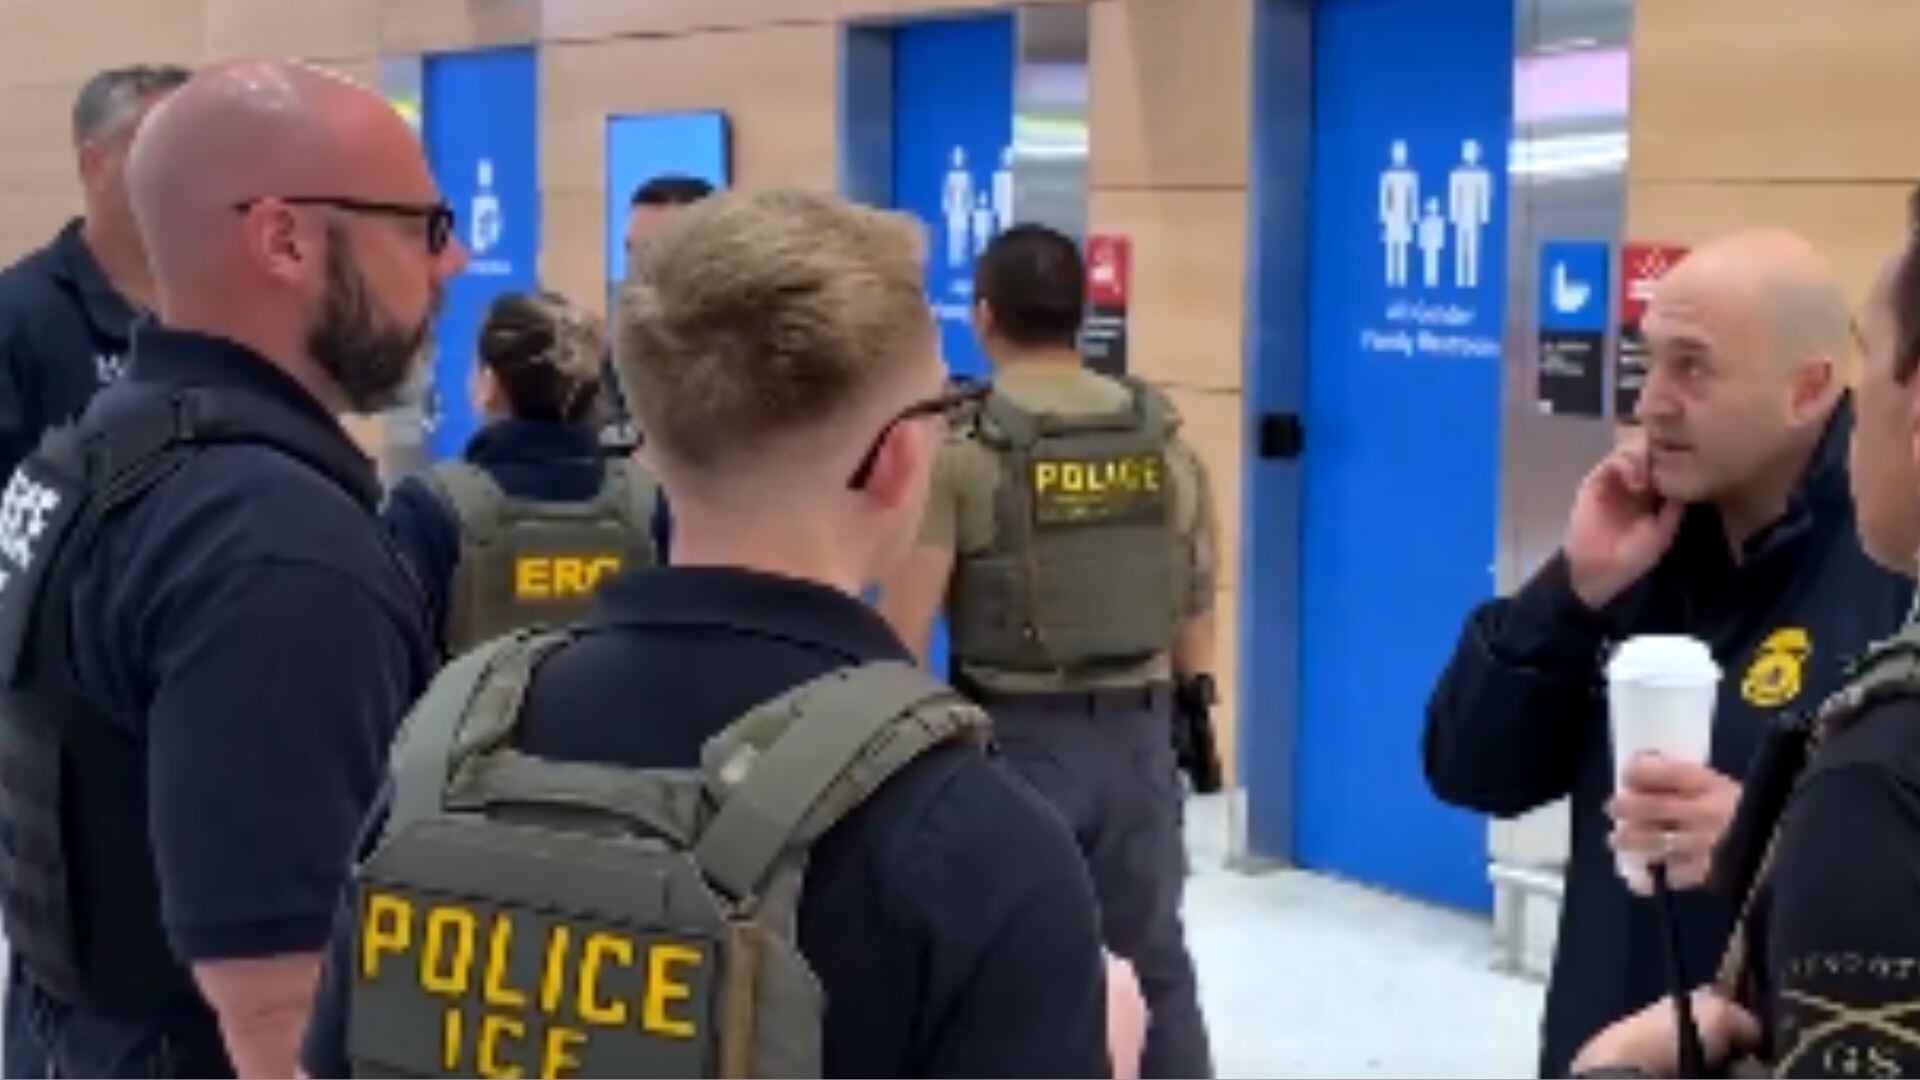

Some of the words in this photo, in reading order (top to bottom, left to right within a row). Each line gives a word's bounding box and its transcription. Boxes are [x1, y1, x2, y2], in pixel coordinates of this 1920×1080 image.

[1035, 456, 1162, 494] POLICE
[363, 890, 703, 1037] POLICE
[444, 1007, 589, 1079] ICE
